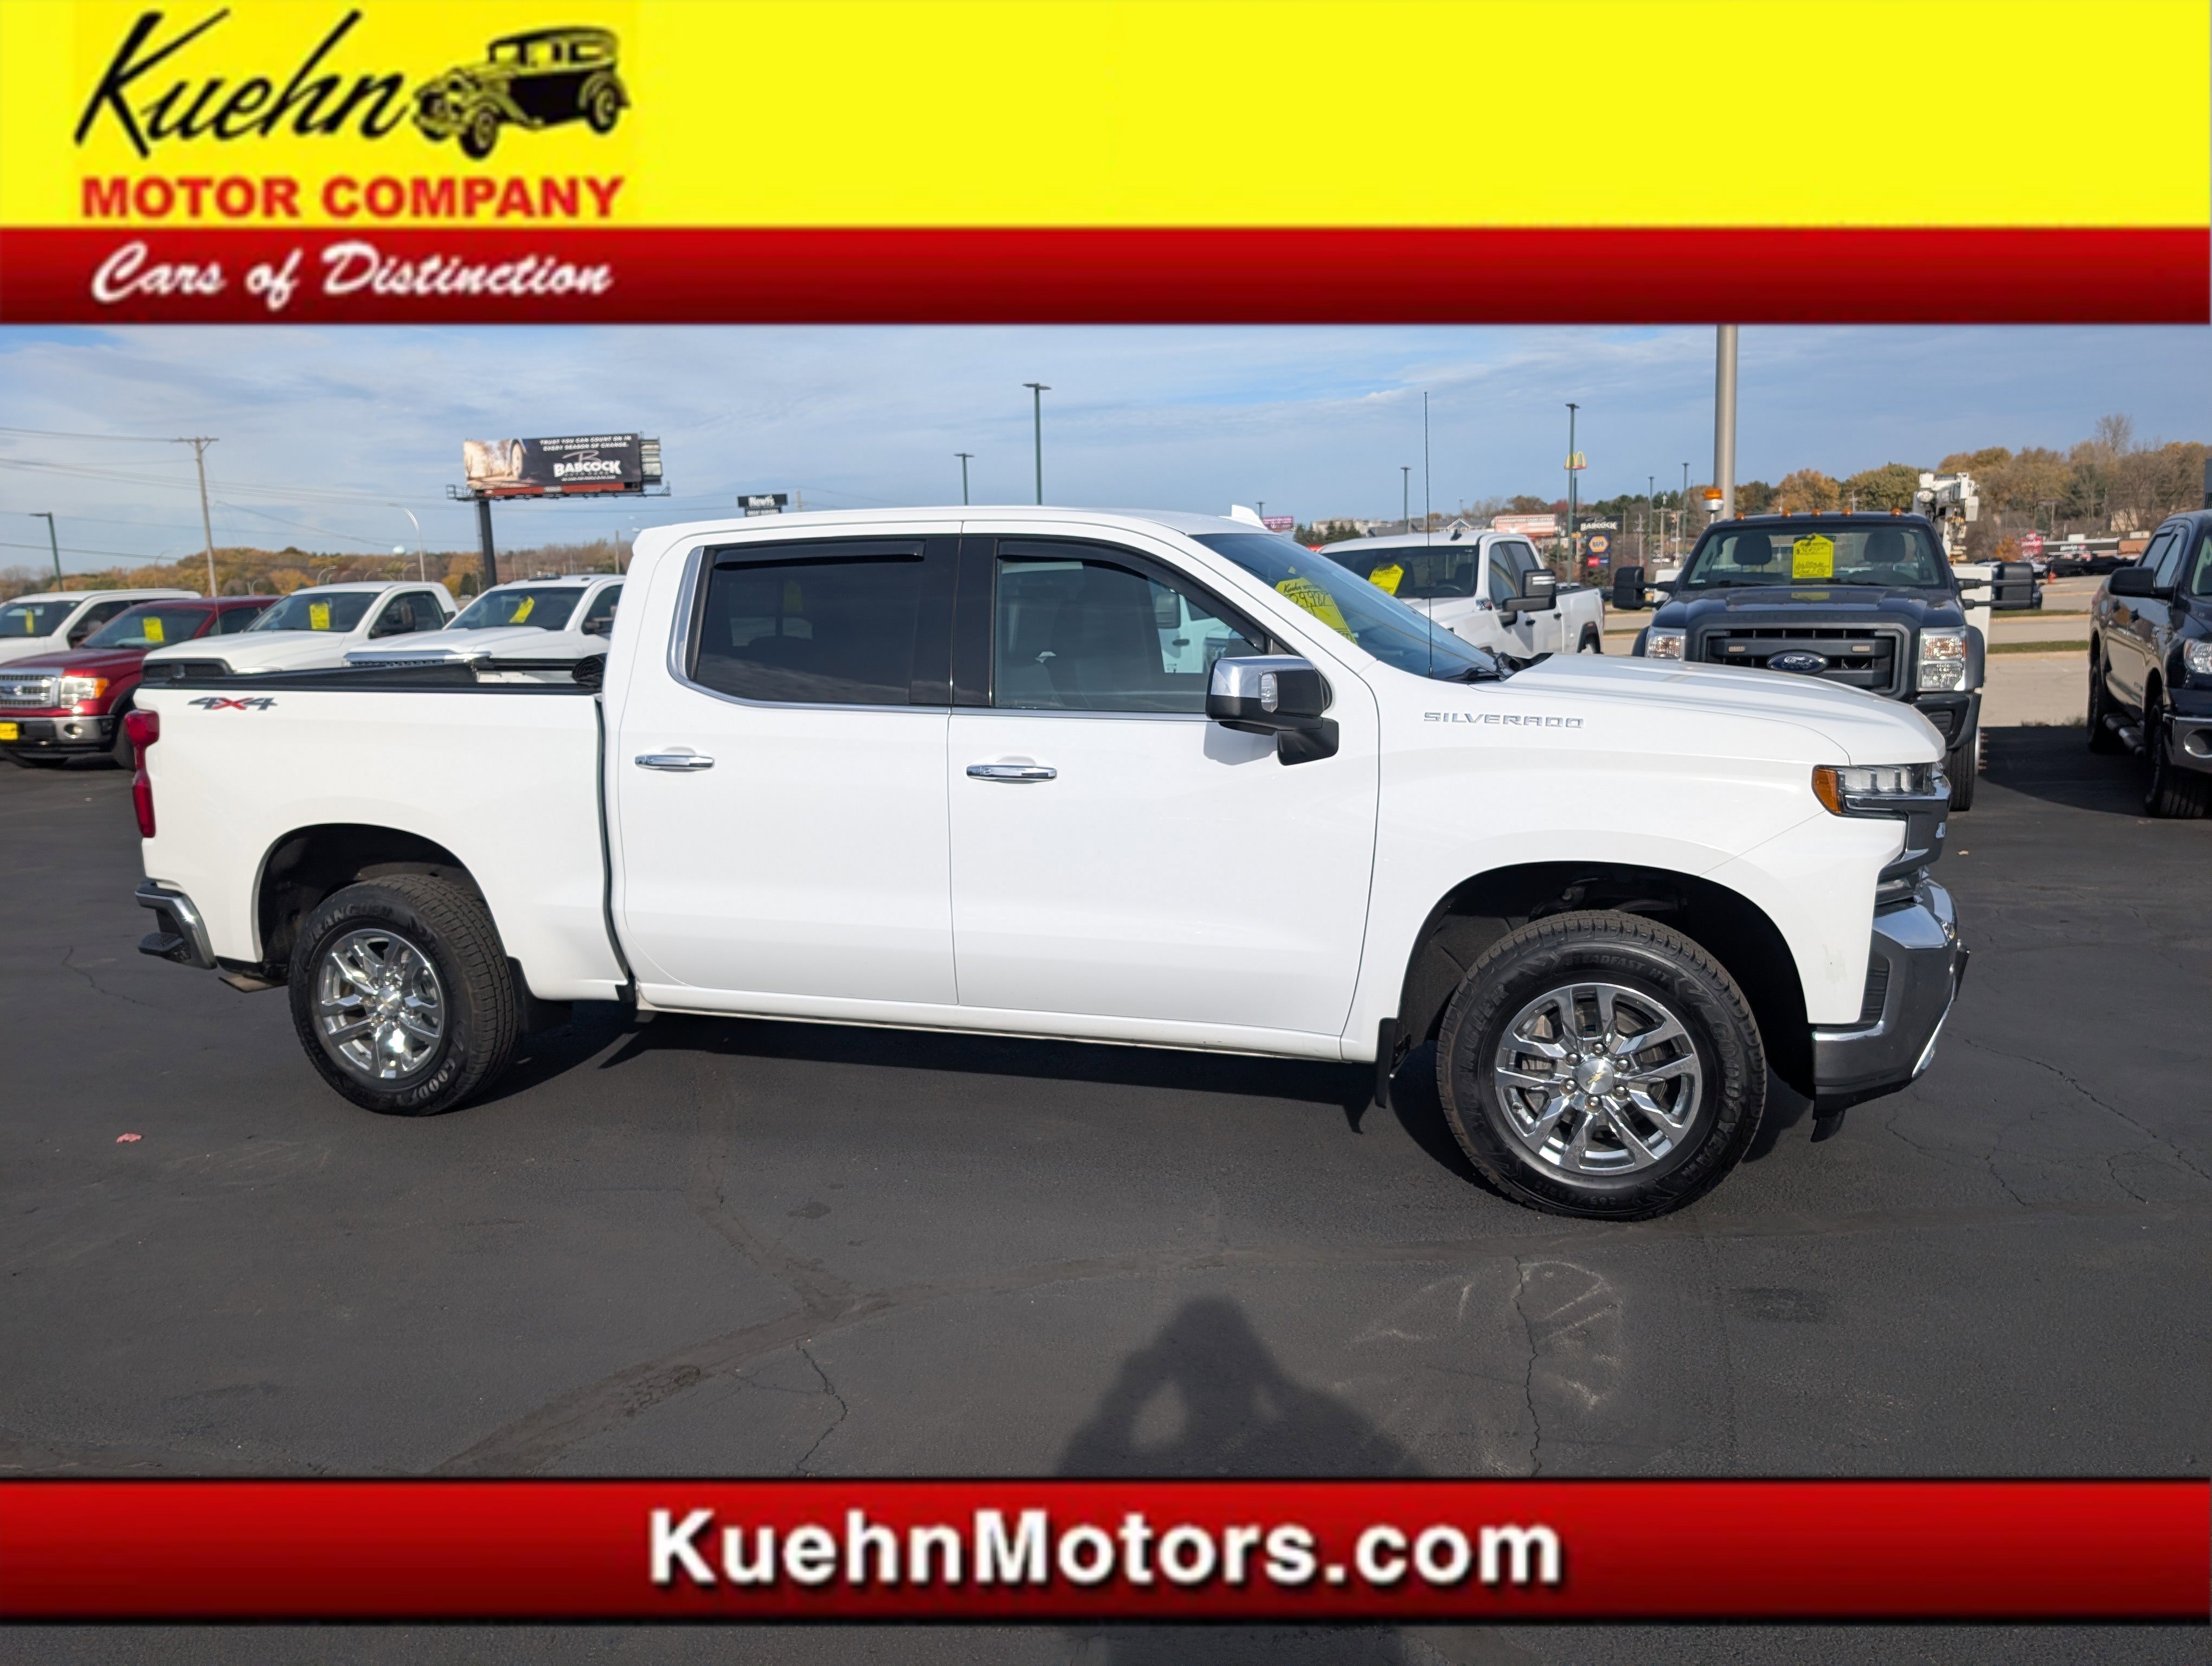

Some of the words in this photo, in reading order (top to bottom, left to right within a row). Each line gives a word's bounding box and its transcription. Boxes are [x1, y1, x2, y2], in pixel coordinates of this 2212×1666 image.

[553, 460, 622, 478] BABCOCK
[1580, 521, 1618, 531] BABCOCK
[1424, 712, 1584, 728] SILVERADO
[1681, 1020, 1742, 1184] GOODYEAR
